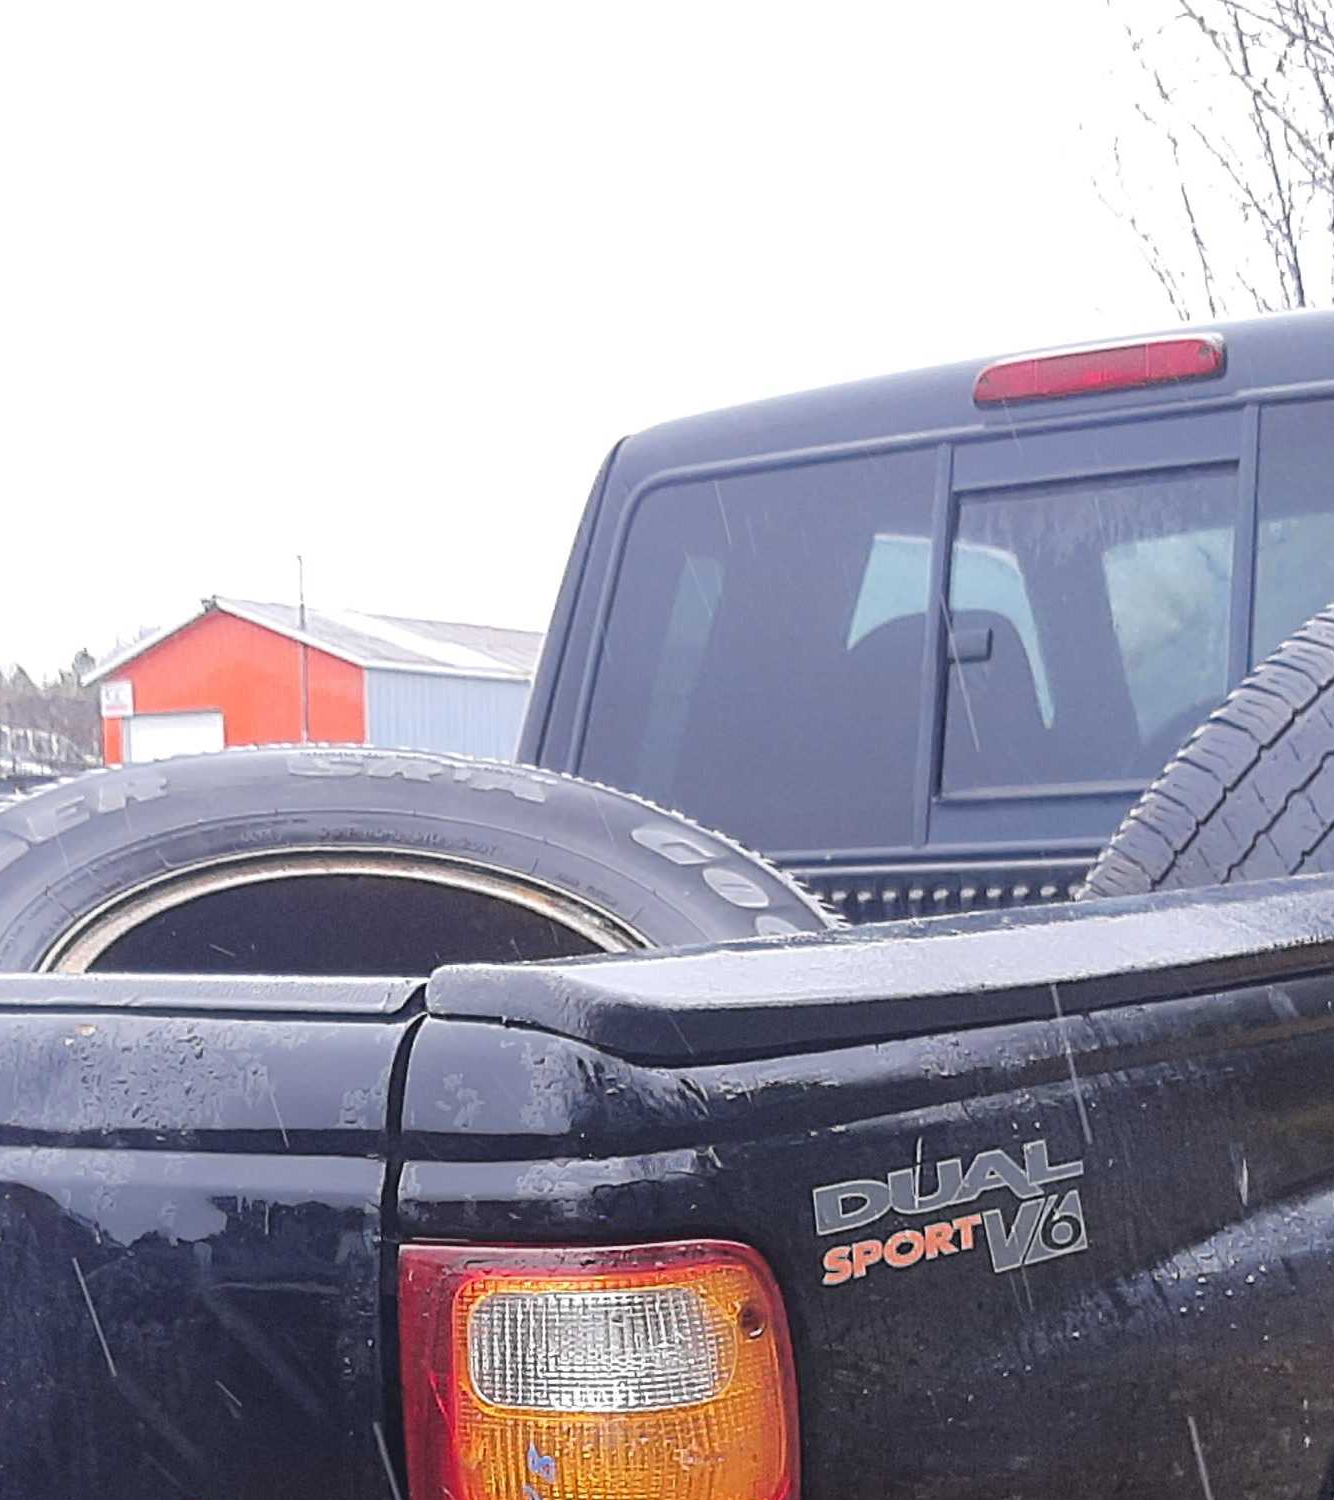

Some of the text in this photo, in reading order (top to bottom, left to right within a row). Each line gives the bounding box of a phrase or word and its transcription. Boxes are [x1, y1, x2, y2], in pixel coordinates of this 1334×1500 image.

[812, 1139, 1084, 1237] DUAL
[821, 1189, 1088, 1286] SPORT V6
